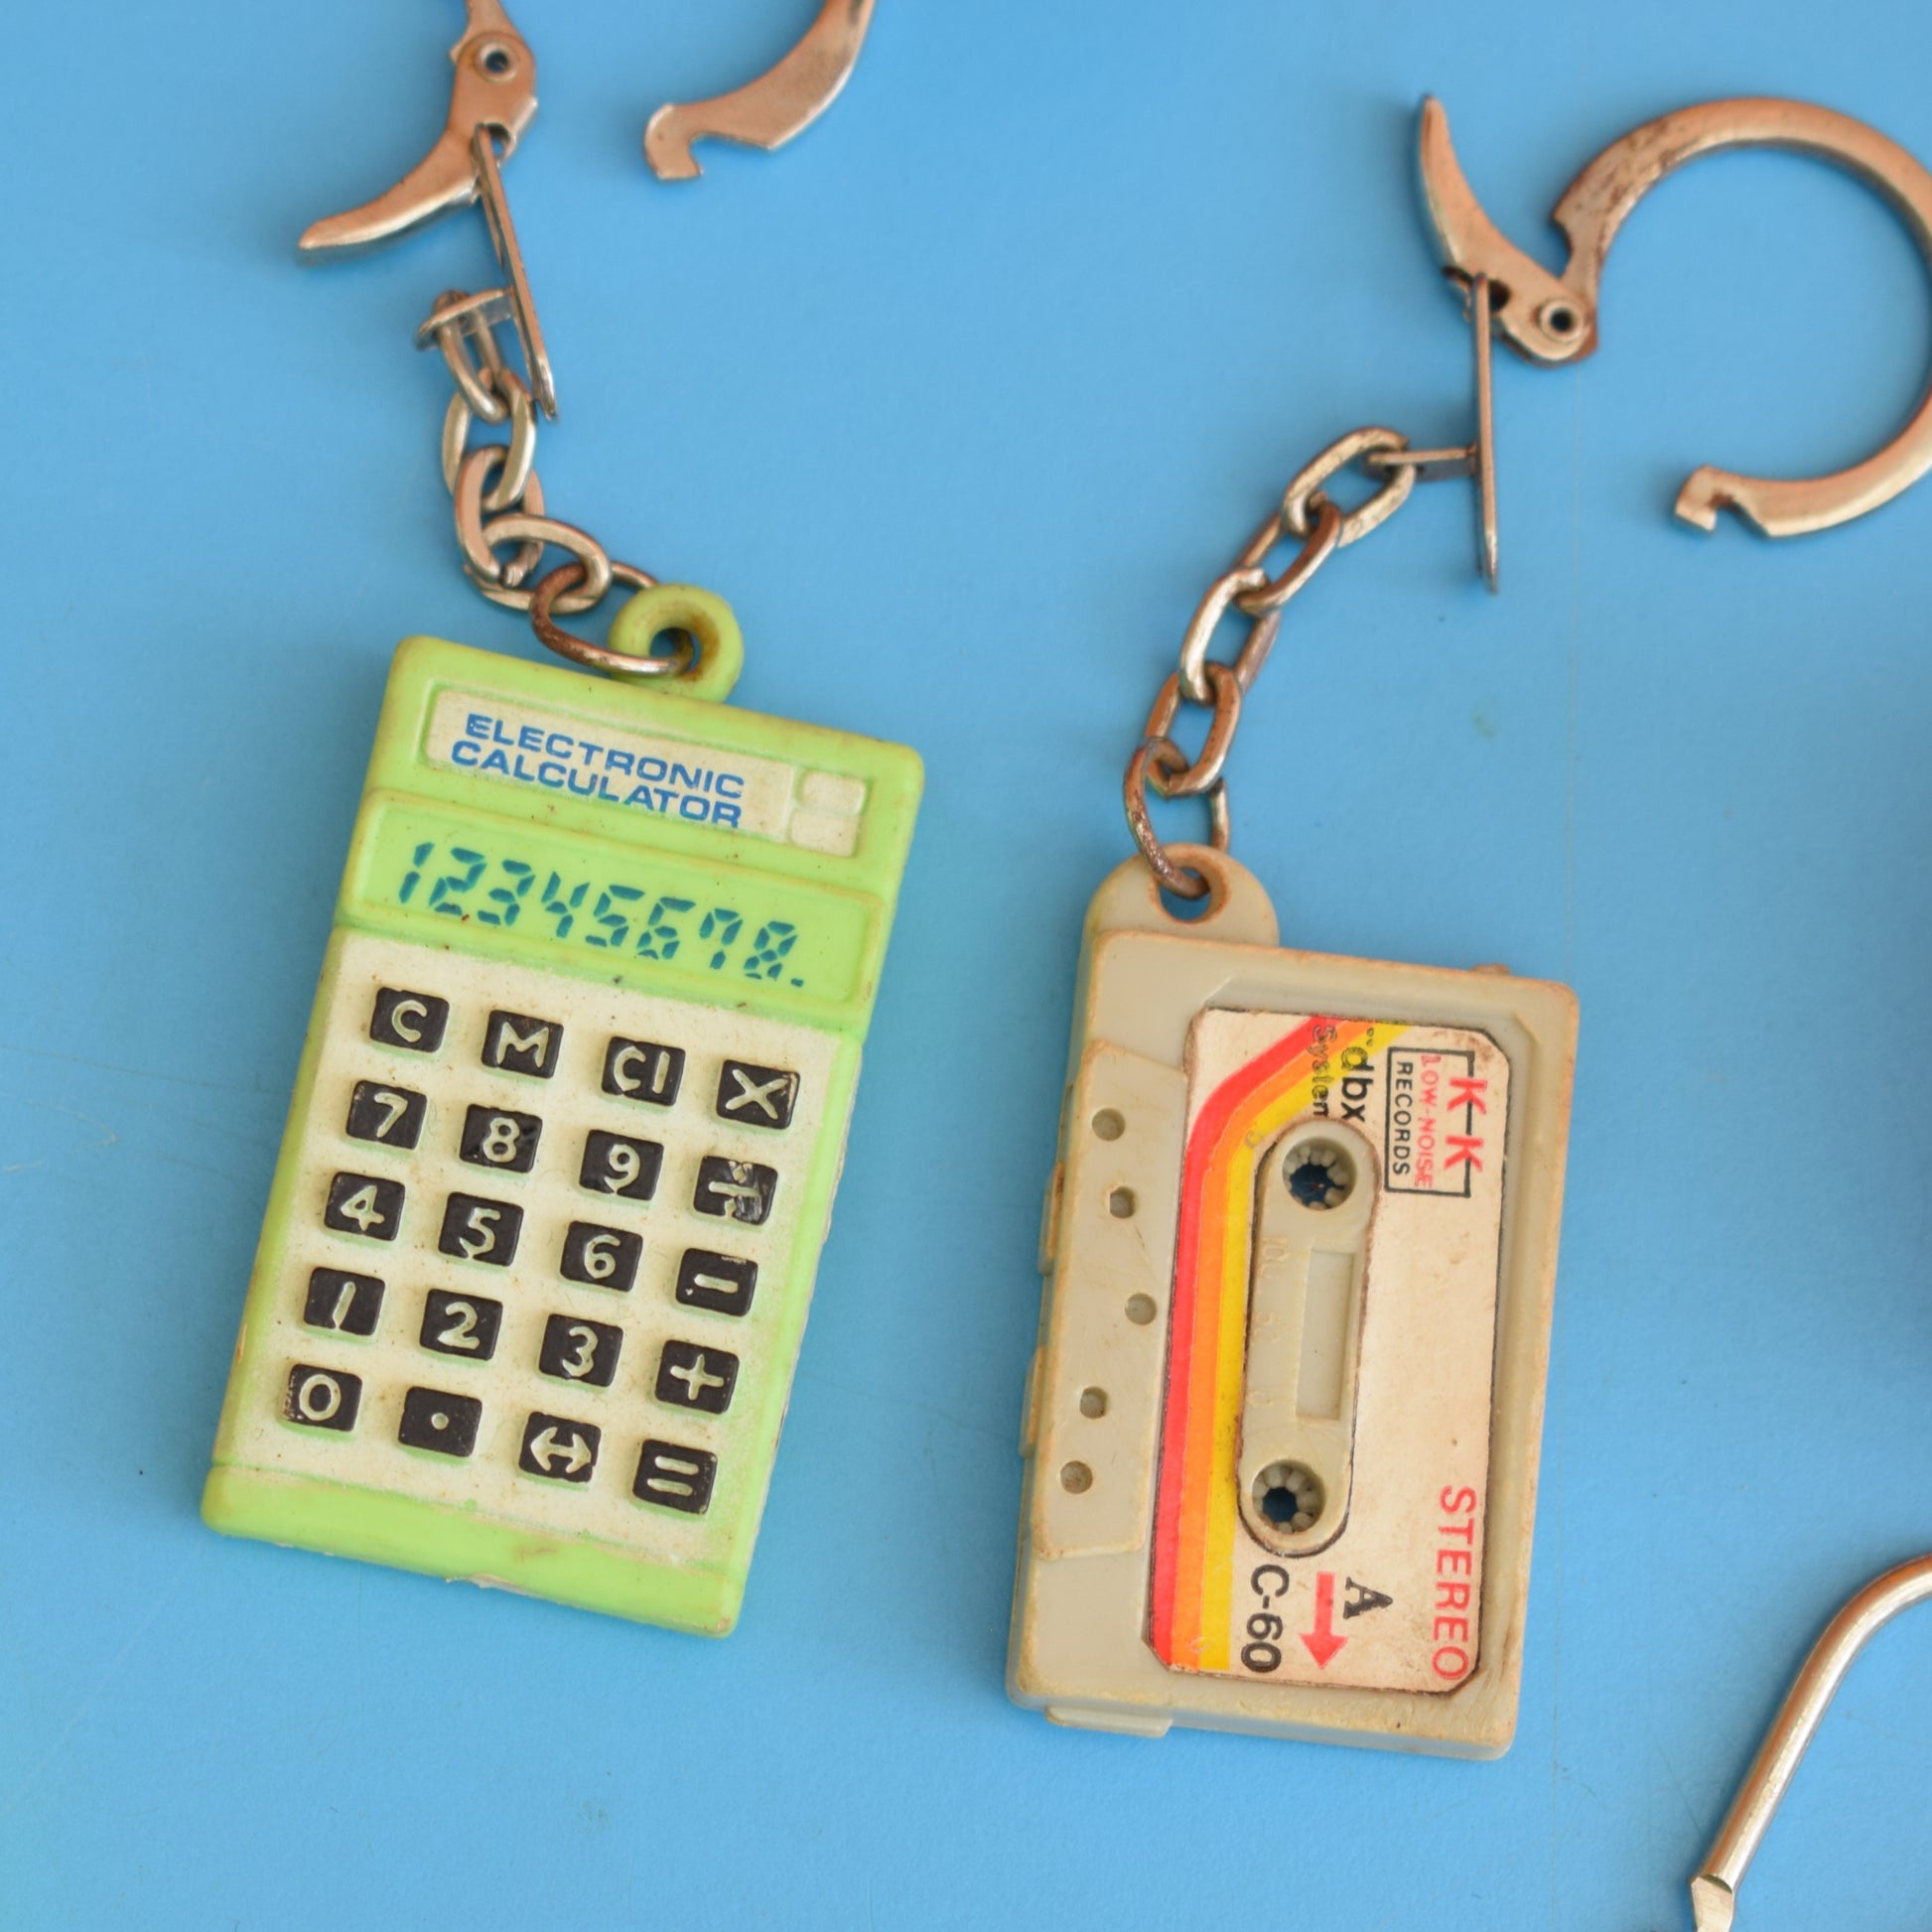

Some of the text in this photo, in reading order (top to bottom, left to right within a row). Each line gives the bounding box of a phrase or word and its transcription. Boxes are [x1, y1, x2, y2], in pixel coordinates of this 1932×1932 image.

[451, 740, 742, 828] CALCULATOR
[466, 713, 745, 799] ELECTRONIC
[391, 999, 428, 1043] C
[496, 1021, 549, 1068] M
[373, 1091, 409, 1139] 7
[483, 1117, 520, 1164] 8
[604, 1143, 640, 1194] 9
[1392, 1060, 1414, 1176] RECORDS
[1414, 1054, 1442, 1188] LOW-NOISE
[340, 1184, 385, 1232] 4
[459, 1206, 501, 1259] 5
[583, 1234, 621, 1280] 6
[437, 1301, 481, 1350] 2
[561, 1325, 599, 1378] 3
[299, 1373, 342, 1422] 0
[1240, 1564, 1290, 1673] C-60
[1342, 1577, 1394, 1620] A
[1431, 1485, 1476, 1680] STEREO
